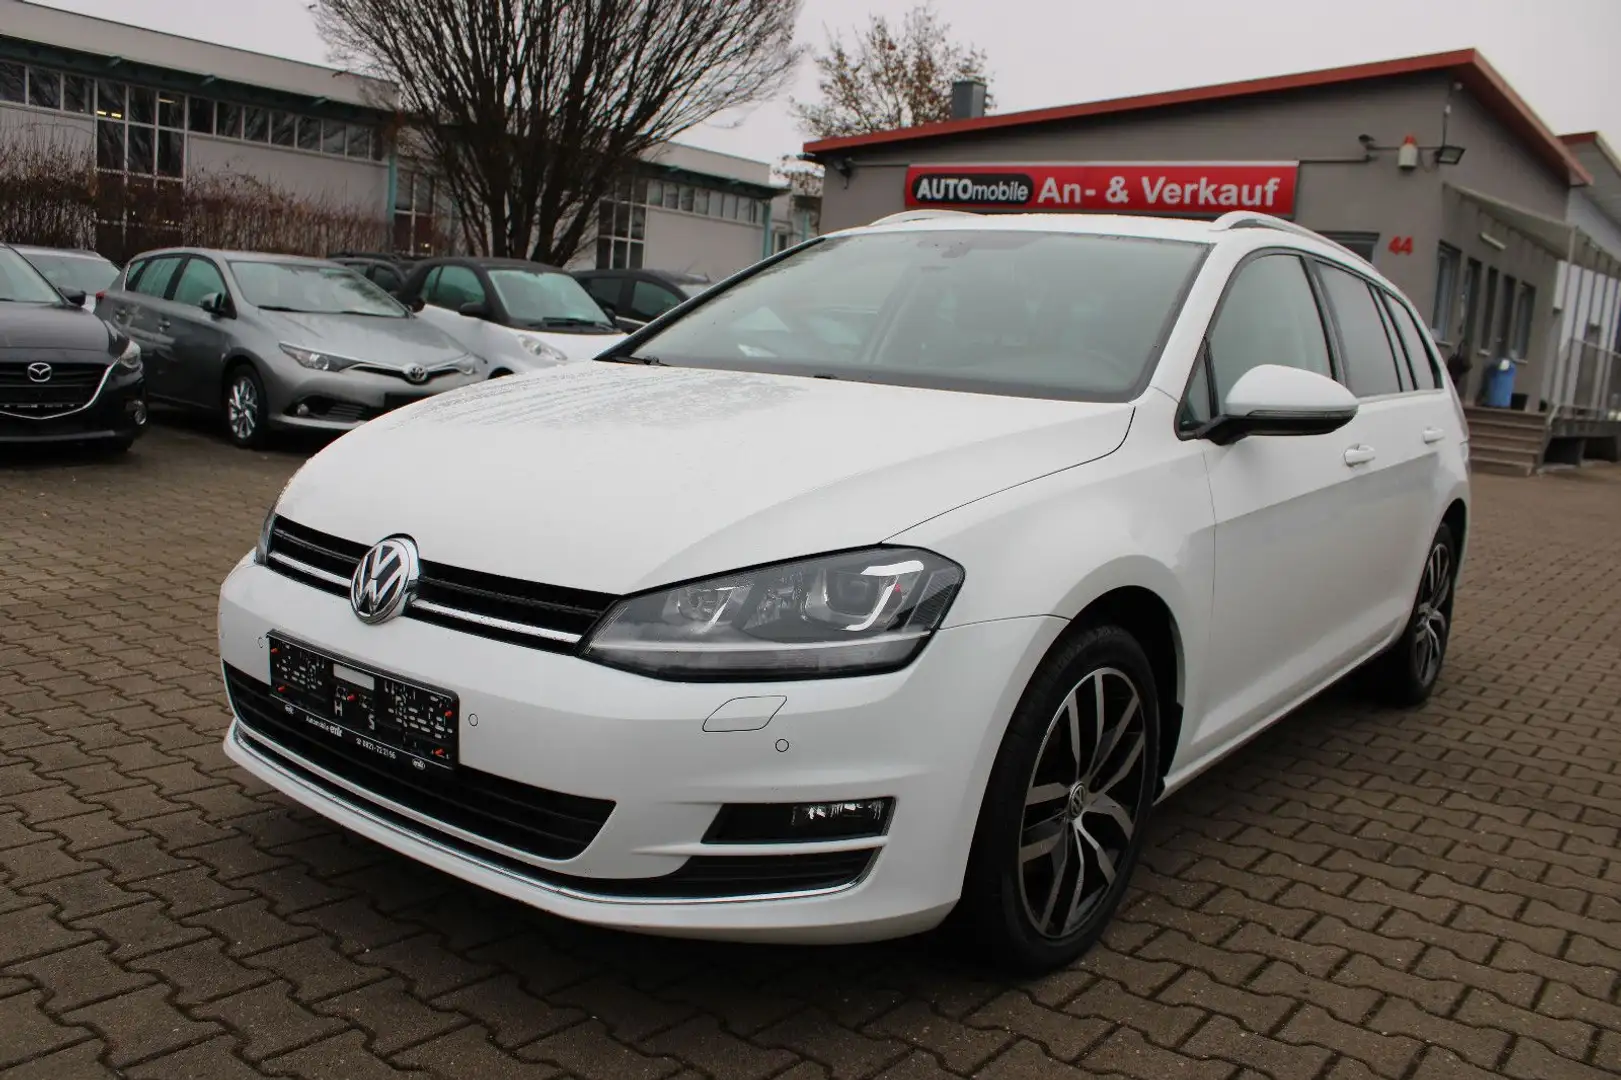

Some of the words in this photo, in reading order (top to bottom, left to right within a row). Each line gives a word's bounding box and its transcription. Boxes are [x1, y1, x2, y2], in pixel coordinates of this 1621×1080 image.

[916, 178, 1029, 200] AUTOmobile
[1038, 177, 1096, 203] An-
[1106, 176, 1129, 203] &
[1141, 177, 1281, 206] Verkauf
[1388, 235, 1413, 256] 44
